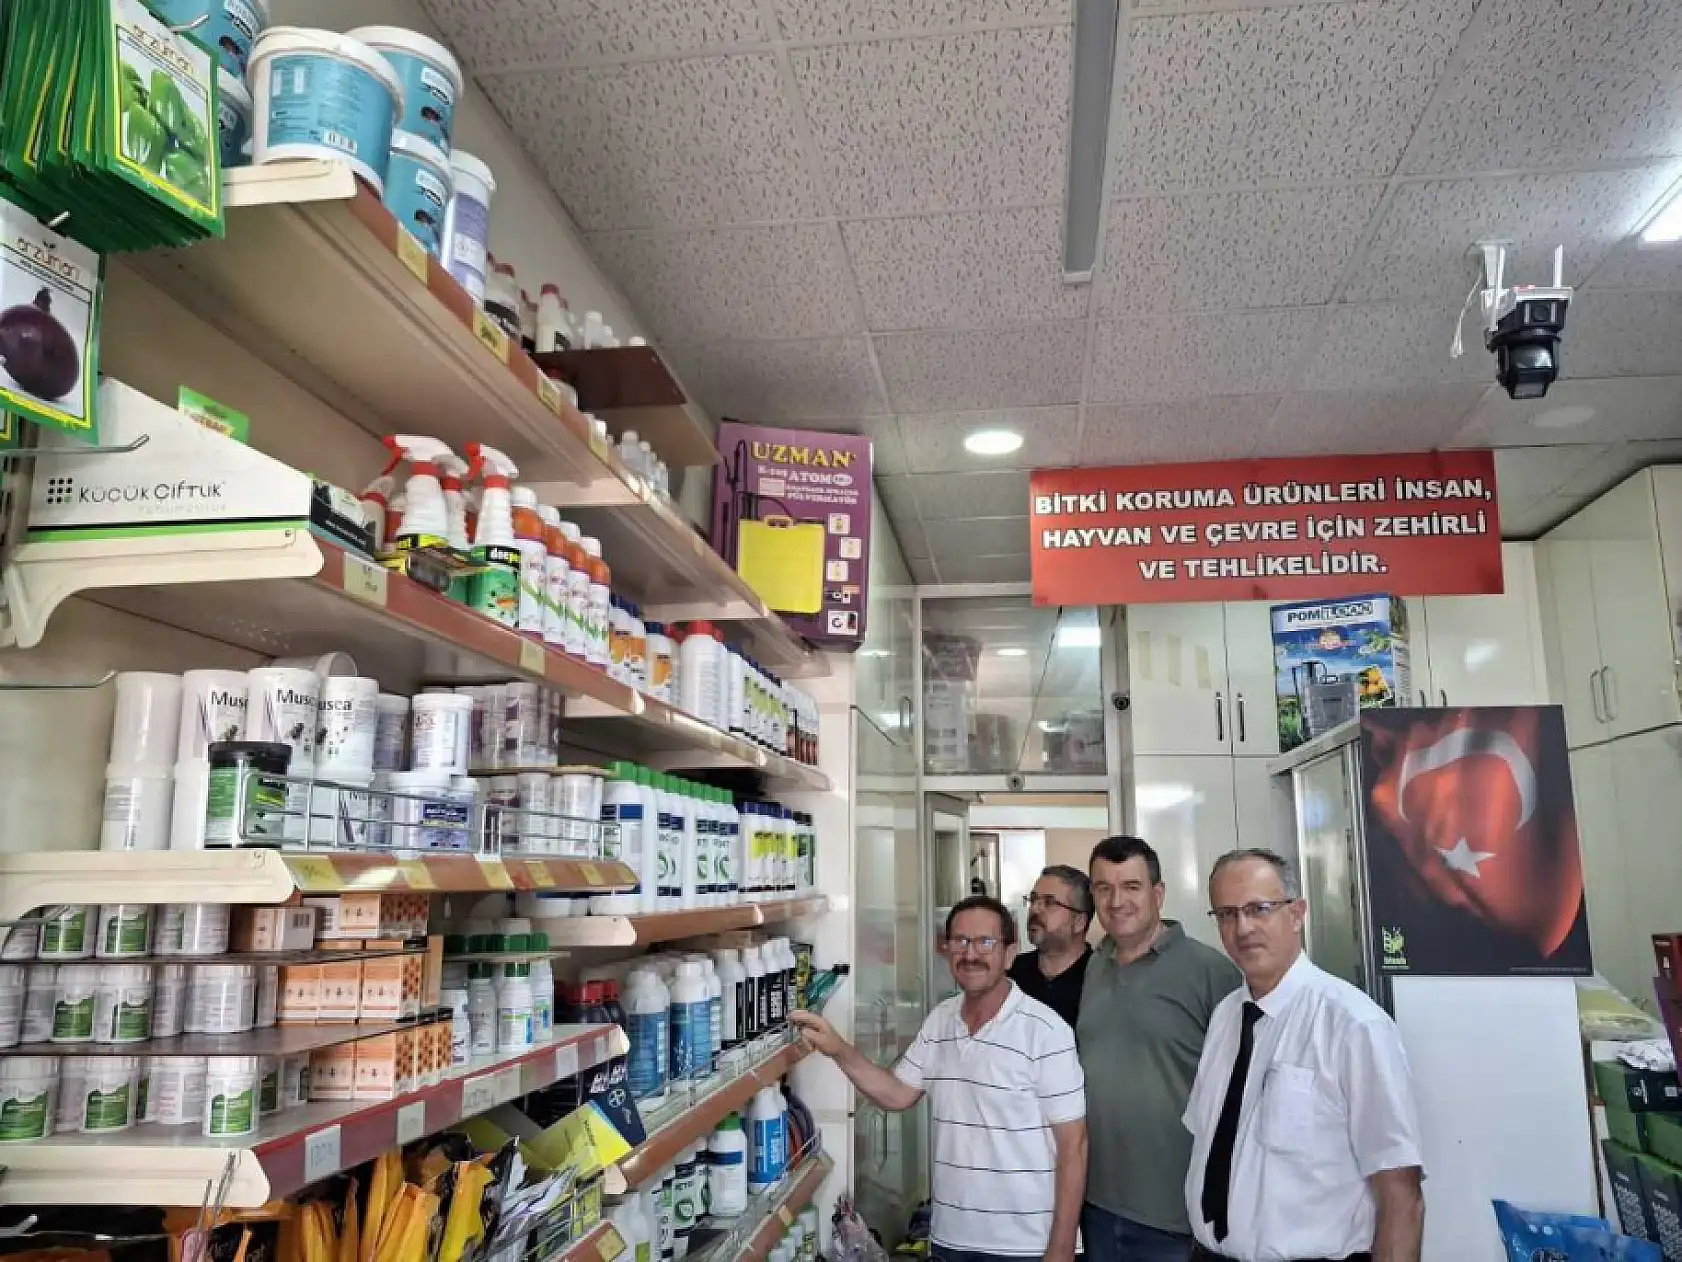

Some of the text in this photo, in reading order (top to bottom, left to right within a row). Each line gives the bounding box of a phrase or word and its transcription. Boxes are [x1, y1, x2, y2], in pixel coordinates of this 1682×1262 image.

[751, 440, 850, 467] UZMAN
[1035, 475, 1492, 515] BİTKİ KORUMA ÜRÜNLERİ İNSAN,
[1042, 509, 1487, 549] HAYVAN VE ÇEVRE İÇİN ZEHİRLİ
[1138, 549, 1389, 580] VE TEHLİKELİDİR.
[317, 699, 354, 712] usca
